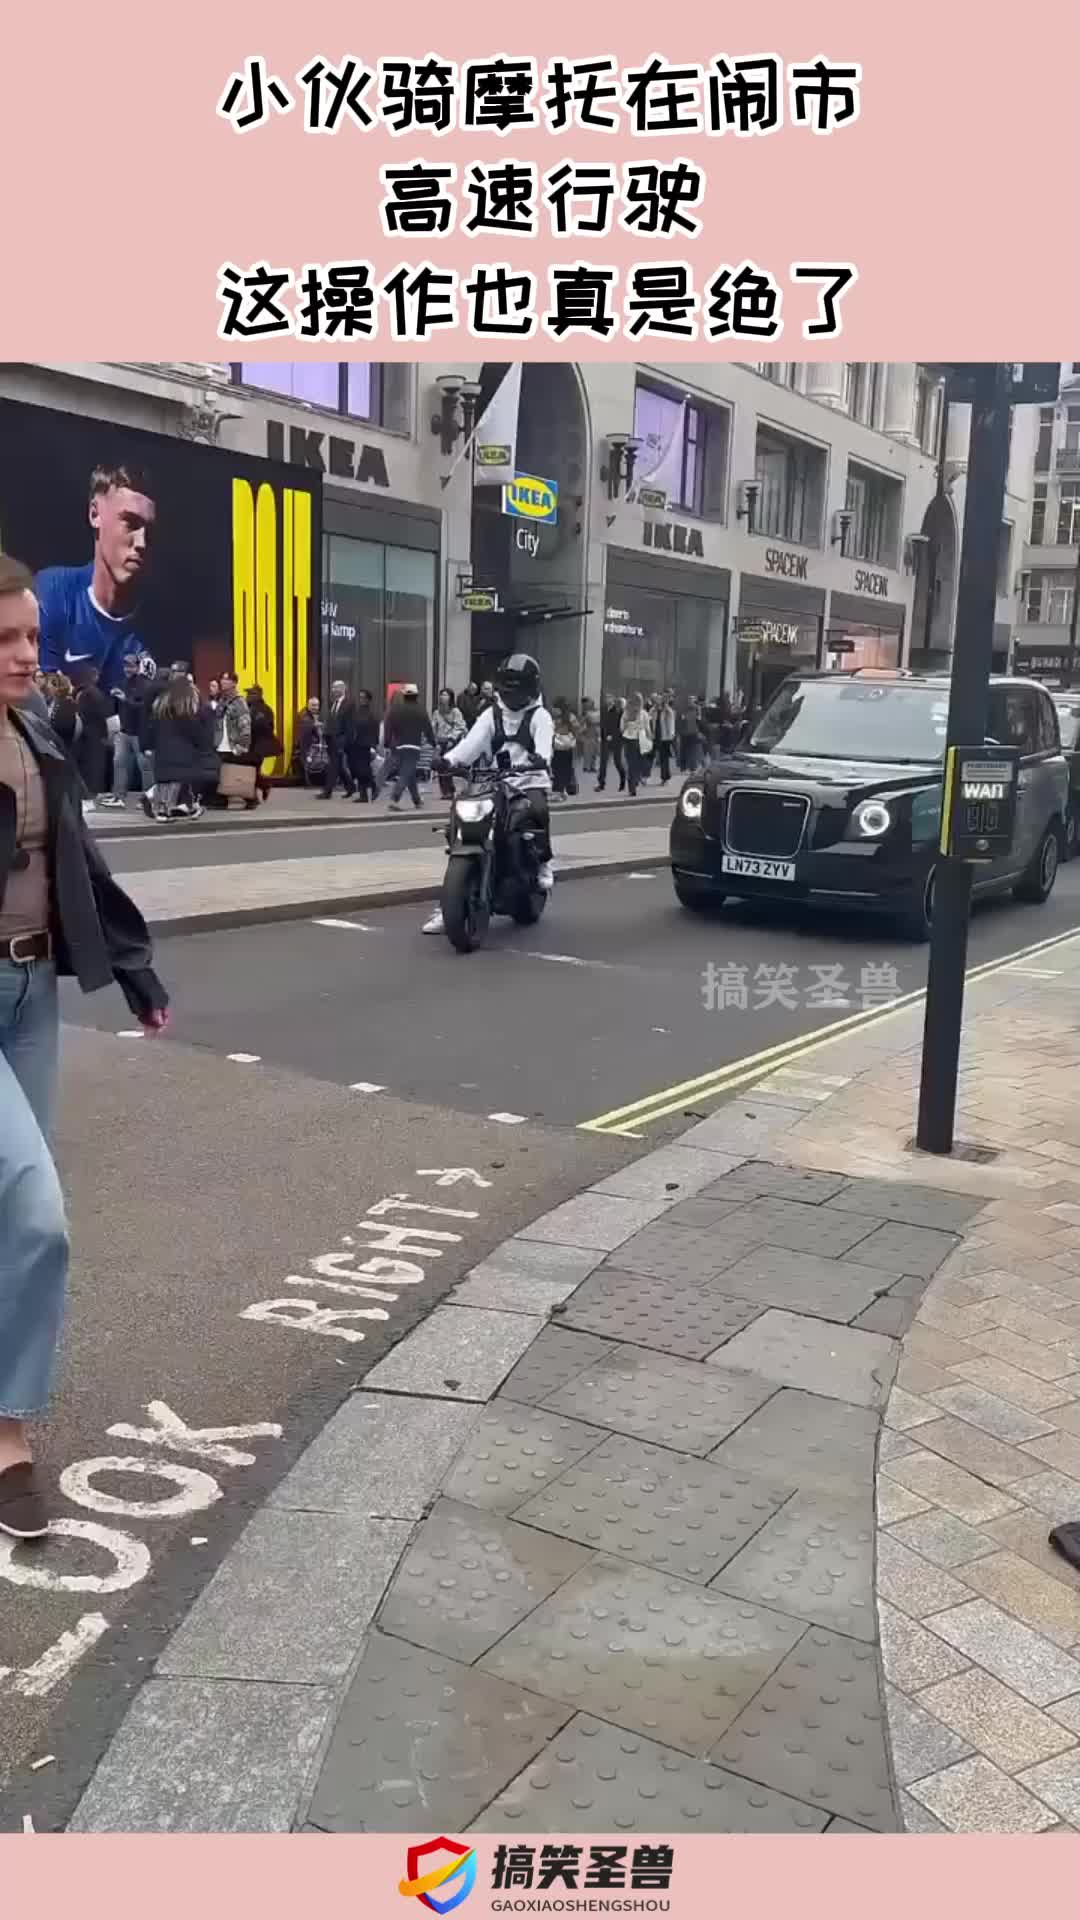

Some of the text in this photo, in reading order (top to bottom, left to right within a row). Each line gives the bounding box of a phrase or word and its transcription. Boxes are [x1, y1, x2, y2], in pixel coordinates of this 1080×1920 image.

[267, 420, 390, 487] IKEA
[511, 485, 552, 509] IKEA
[516, 528, 540, 557] City
[643, 521, 704, 558] IKEA
[330, 620, 356, 640] lamp
[964, 783, 1004, 799] WAIT
[726, 858, 790, 878] LN73 ZYV
[239, 1193, 480, 1343] RIGHT
